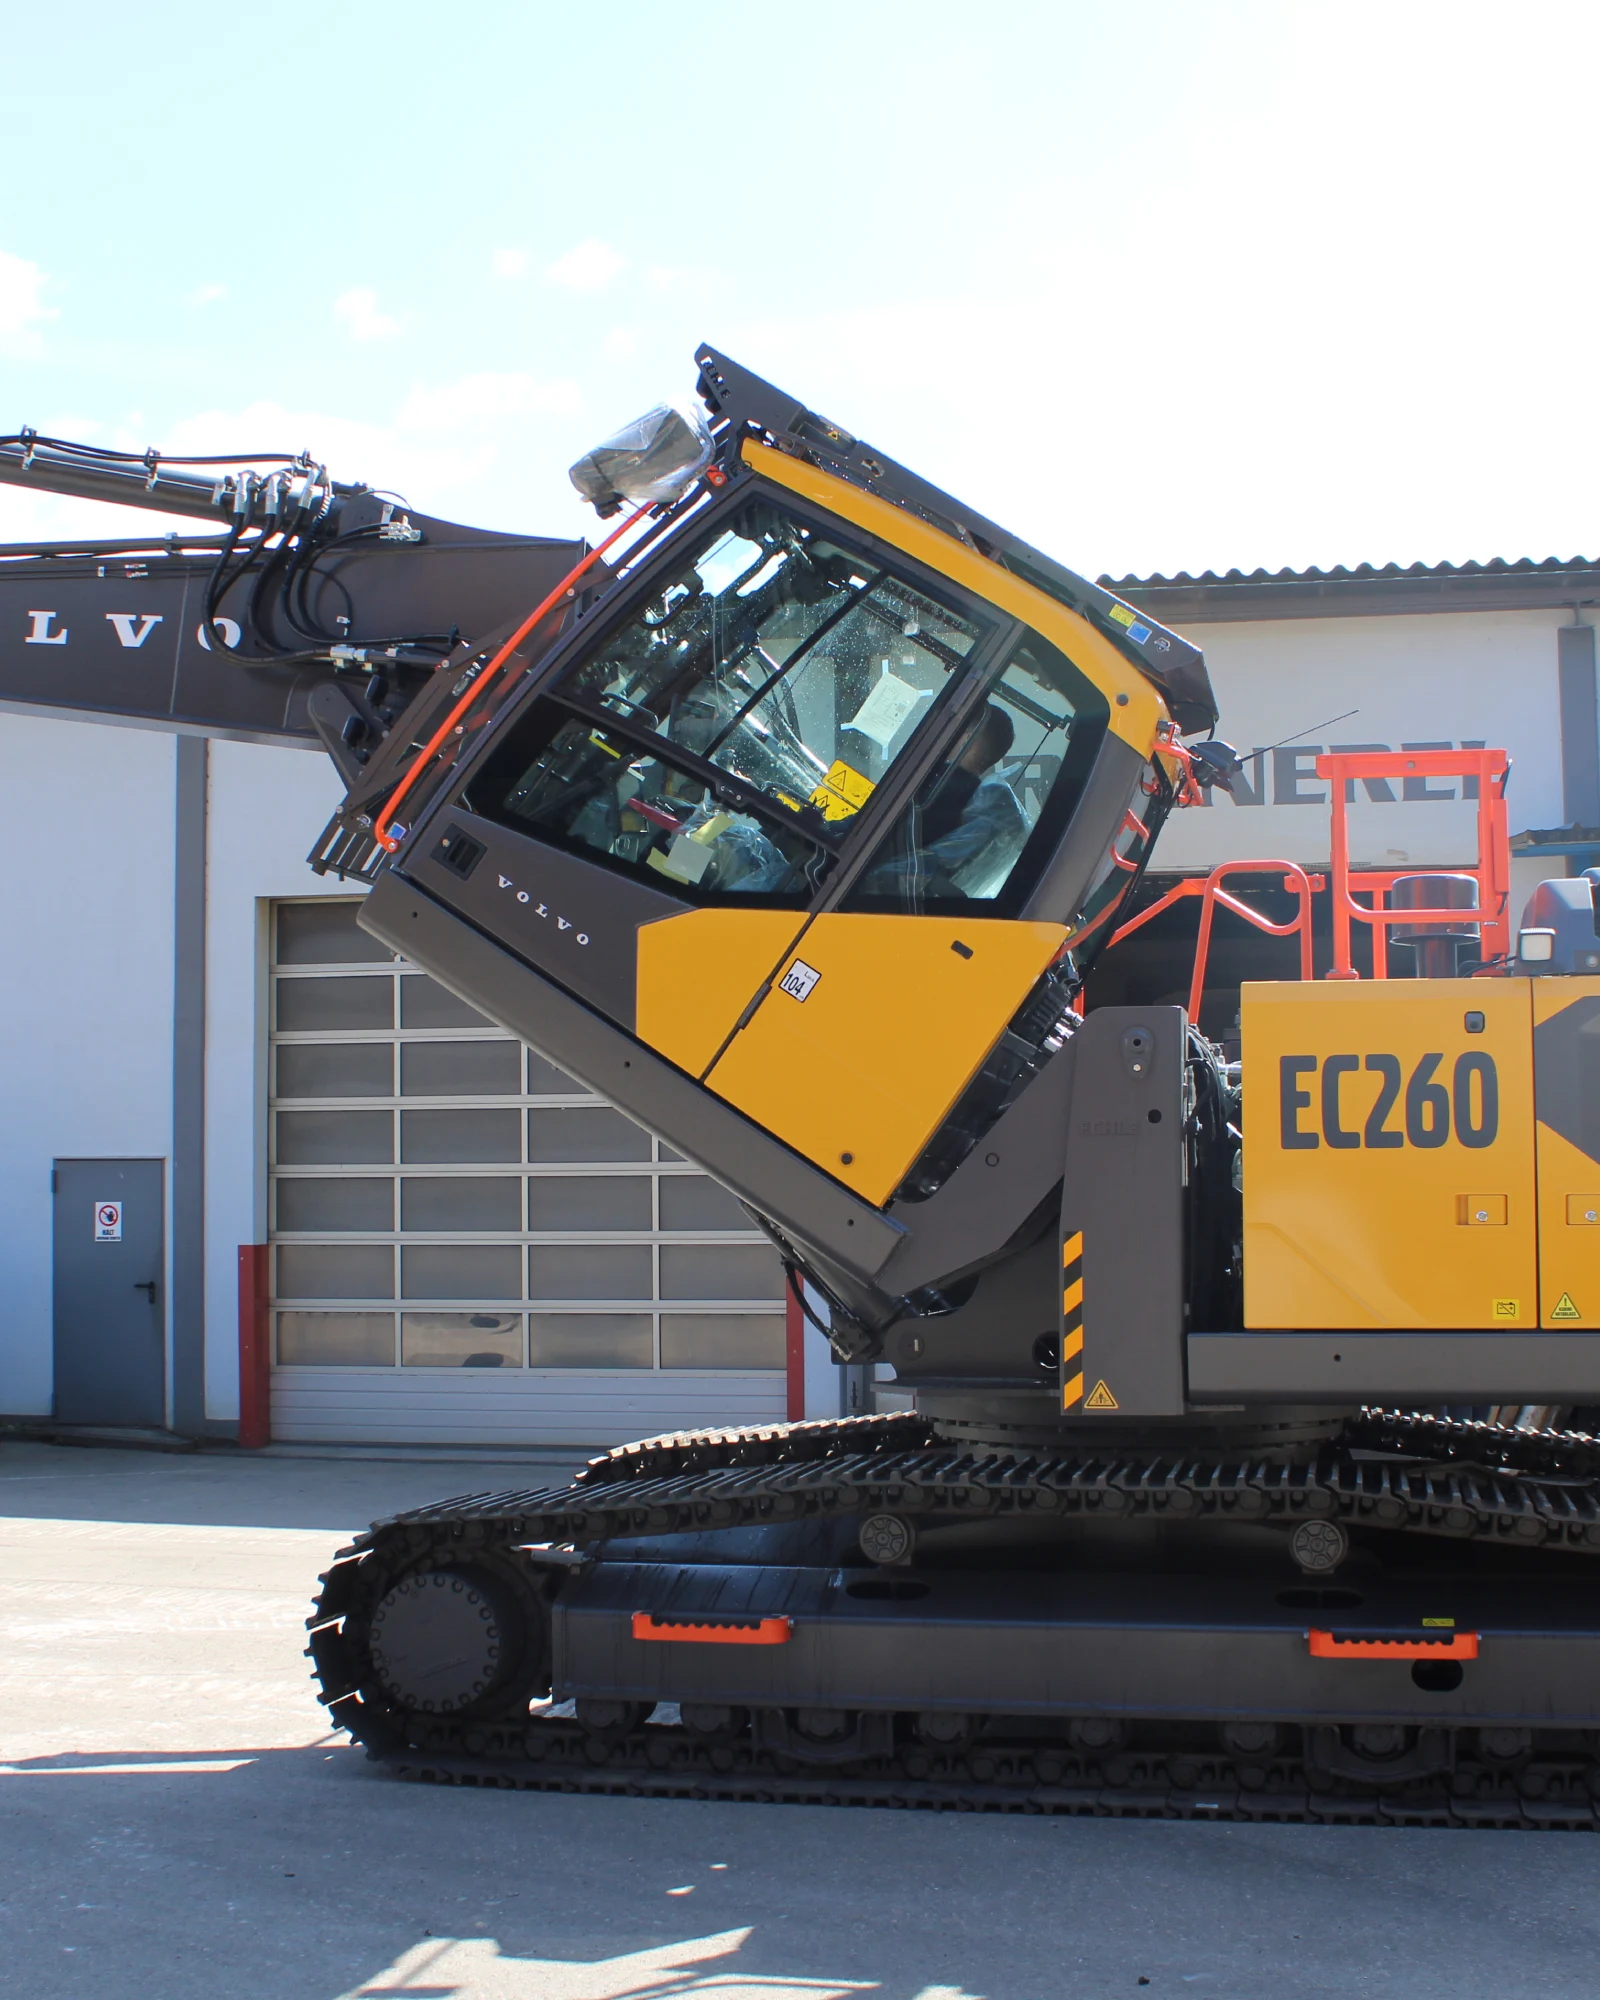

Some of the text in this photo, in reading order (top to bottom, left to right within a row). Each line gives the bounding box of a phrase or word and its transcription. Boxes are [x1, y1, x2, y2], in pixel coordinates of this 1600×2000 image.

[498, 874, 589, 946] VOLVO
[783, 973, 806, 996] 104
[1279, 1051, 1499, 1149] EC260
